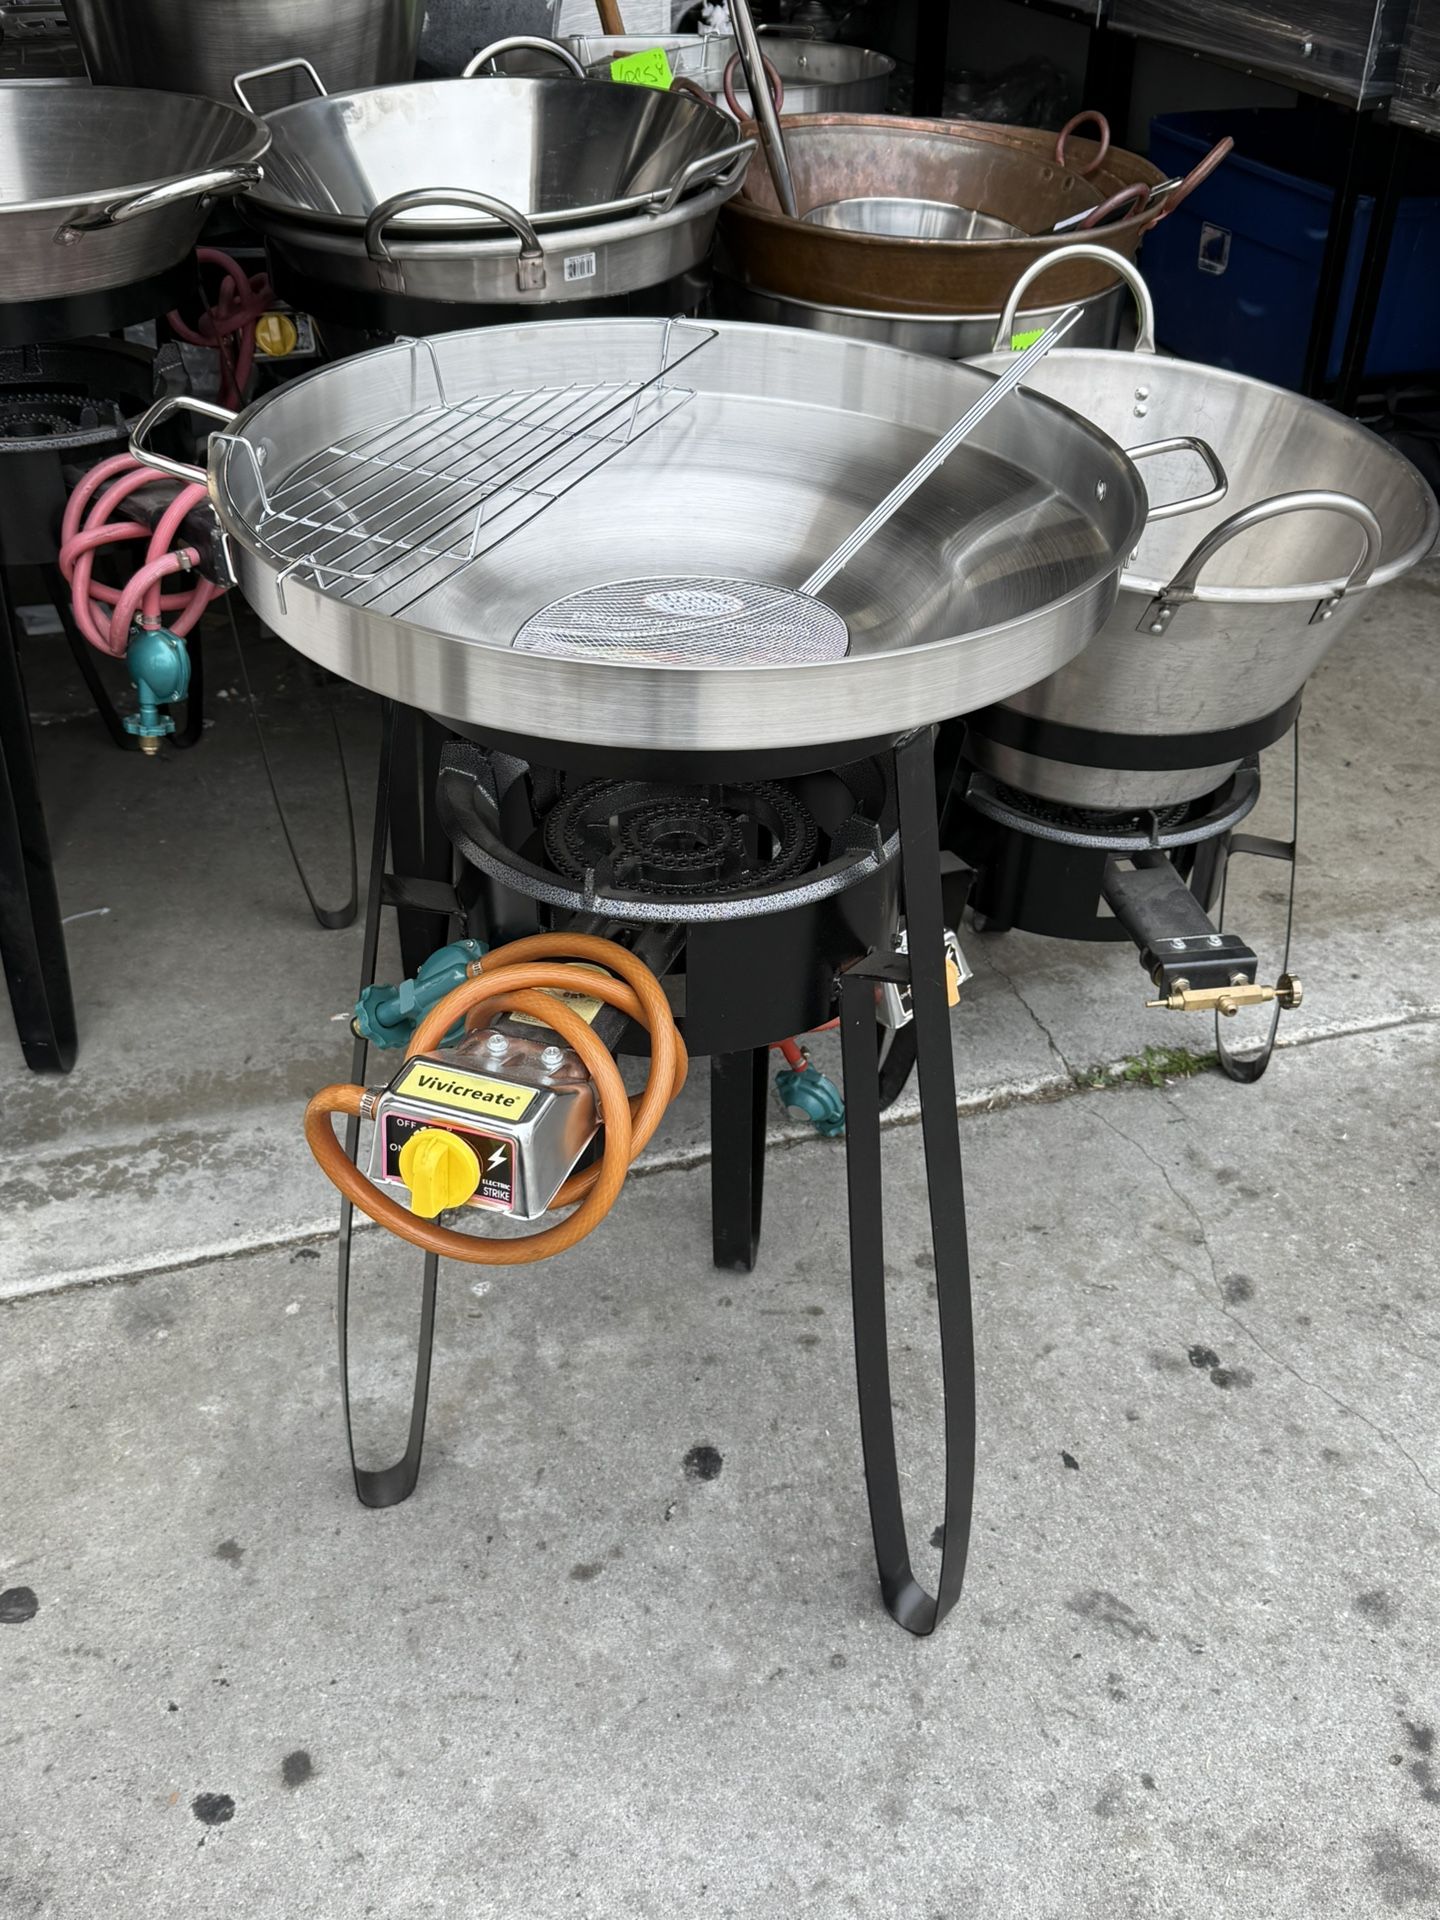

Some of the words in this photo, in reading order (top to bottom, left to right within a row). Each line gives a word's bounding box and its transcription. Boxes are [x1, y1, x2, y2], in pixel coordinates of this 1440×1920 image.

[396, 1118, 417, 1129] OFF
[482, 1178, 512, 1191] ELECTRIC
[483, 1186, 511, 1201] STRIKE
